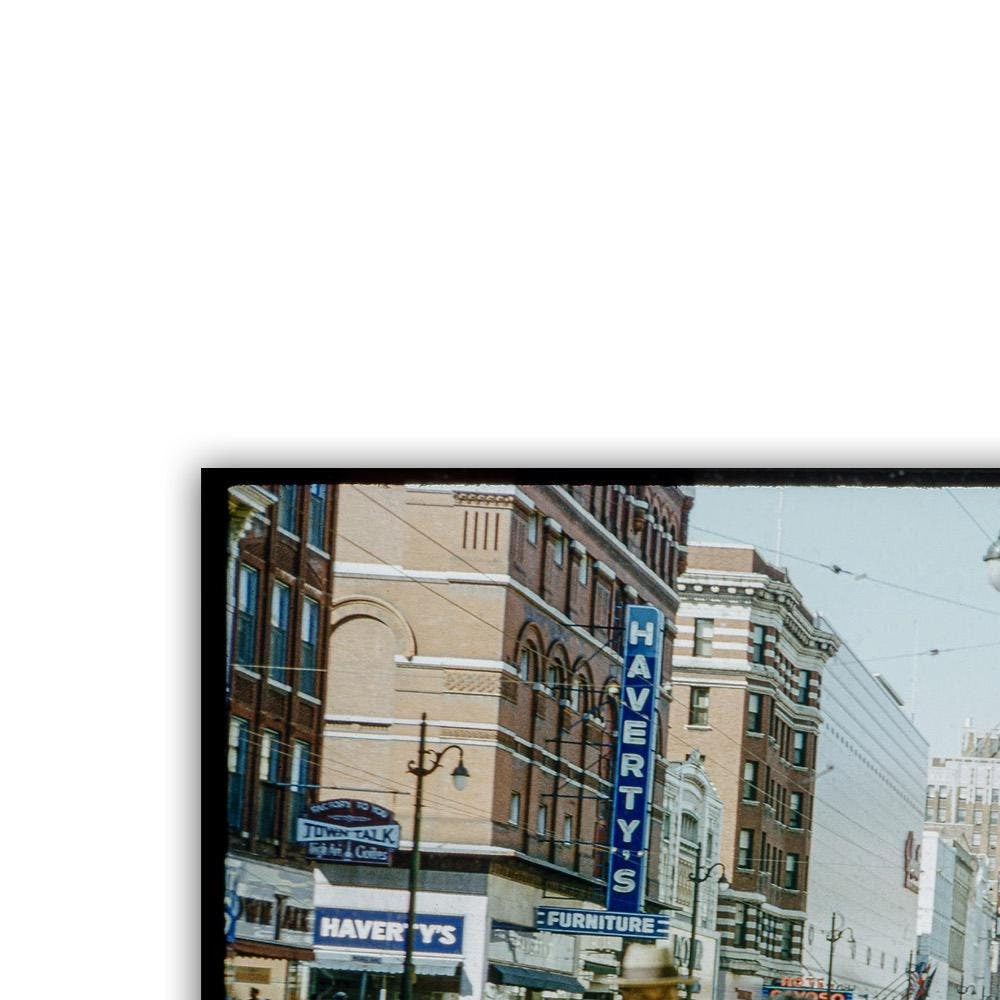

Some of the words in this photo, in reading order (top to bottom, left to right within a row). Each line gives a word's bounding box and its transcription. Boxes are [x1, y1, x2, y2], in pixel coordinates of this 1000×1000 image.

[612, 620, 655, 893] HAVERTY'S
[355, 828, 395, 844] TALK
[546, 911, 656, 934] FURNITURE
